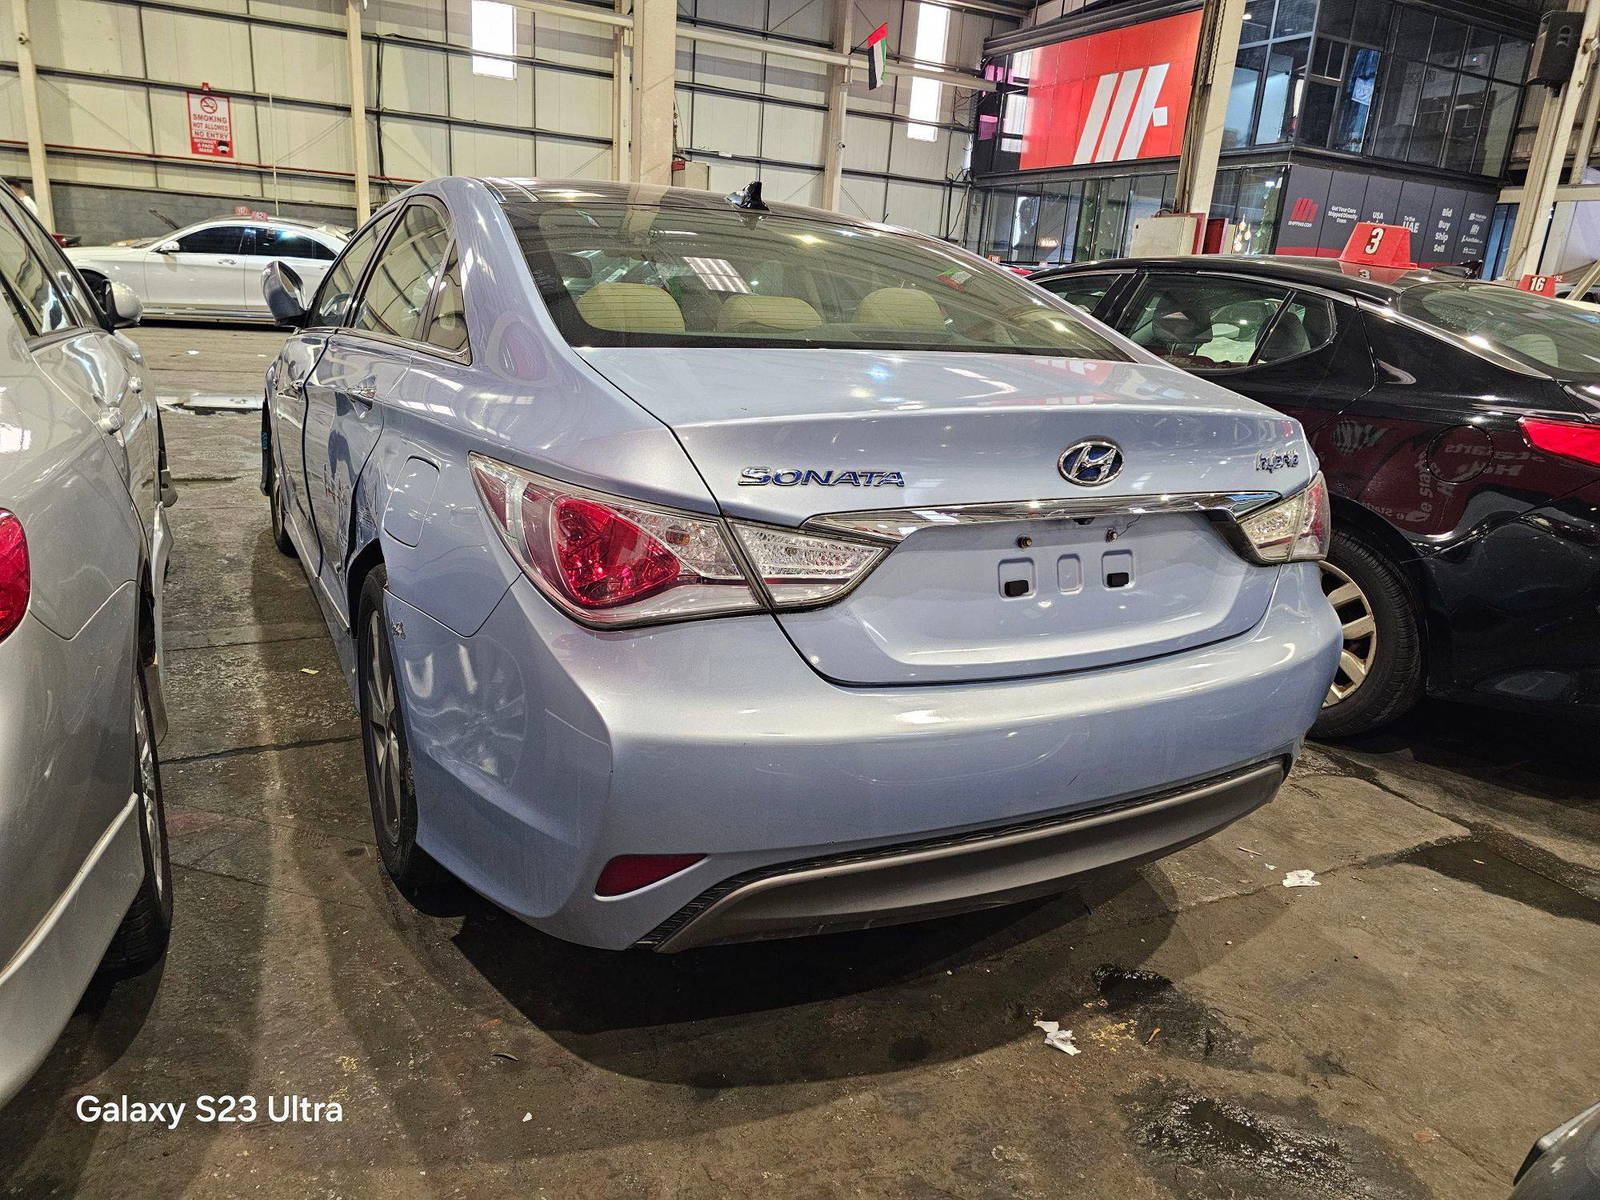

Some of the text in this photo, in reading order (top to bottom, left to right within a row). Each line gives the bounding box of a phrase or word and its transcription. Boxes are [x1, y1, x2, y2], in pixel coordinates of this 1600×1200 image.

[193, 113, 227, 124] SMOKING
[205, 123, 228, 131] ALLOWED
[1372, 212, 1384, 220] USA
[1442, 208, 1453, 217] Bid
[1402, 221, 1420, 233] UAE
[1438, 220, 1451, 231] Buy
[1365, 227, 1384, 254] 3
[1435, 232, 1449, 243] Ship
[1433, 244, 1445, 253] Sell
[1529, 276, 1547, 292] 16
[738, 466, 905, 487] SONATA
